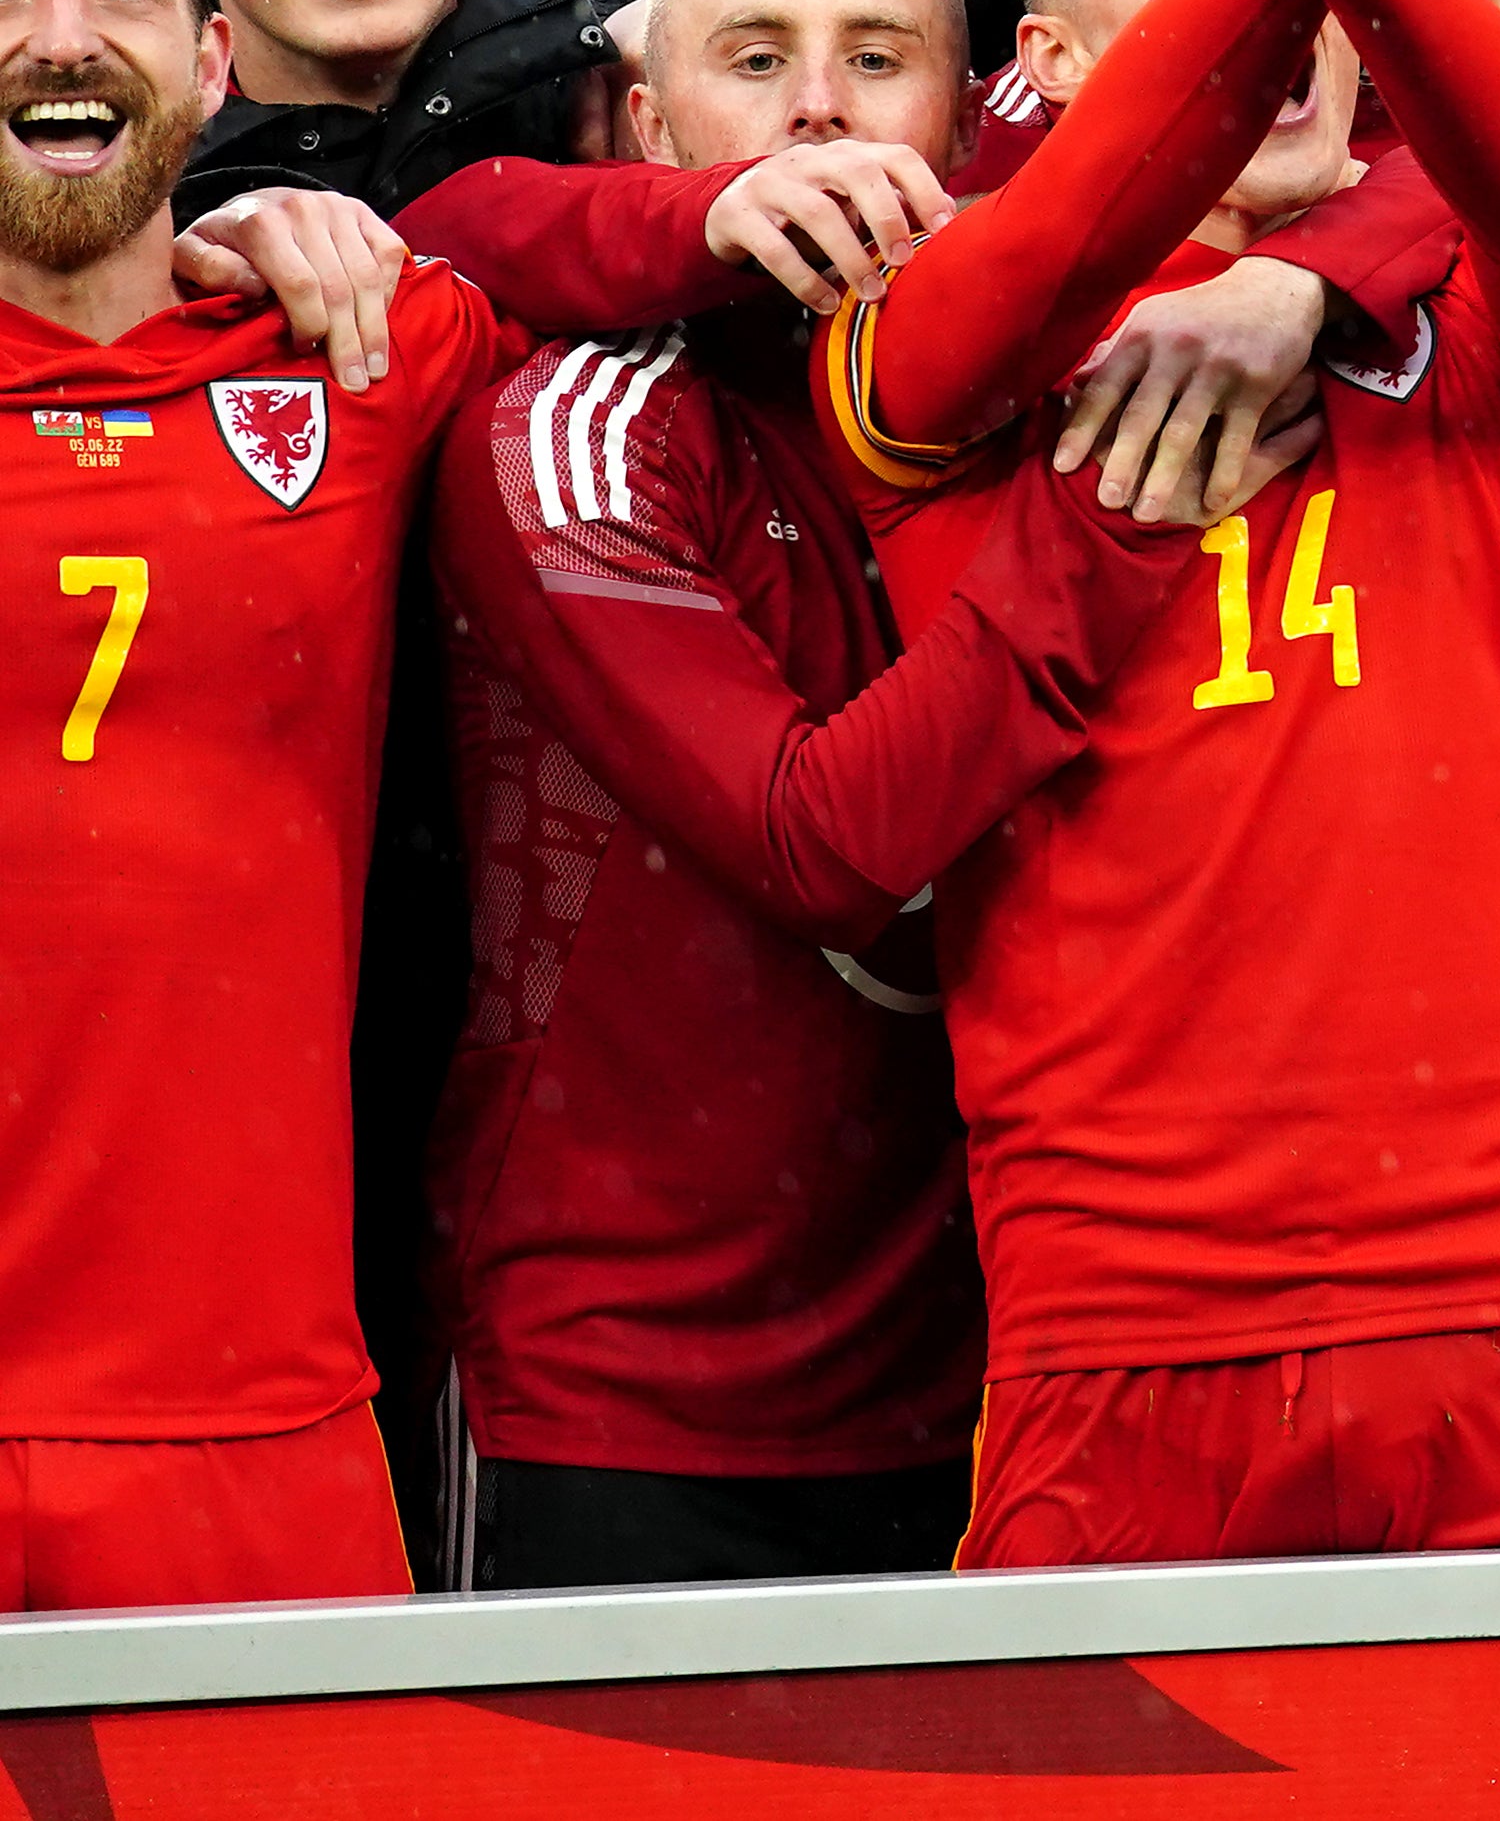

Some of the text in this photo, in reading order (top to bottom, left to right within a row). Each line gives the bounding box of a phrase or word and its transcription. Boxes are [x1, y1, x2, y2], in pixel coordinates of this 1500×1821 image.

[84, 416, 102, 430] VS
[69, 438, 124, 453] 05.06.22
[99, 453, 121, 468] 689
[1192, 488, 1362, 711] 14
[59, 556, 149, 762] 7
